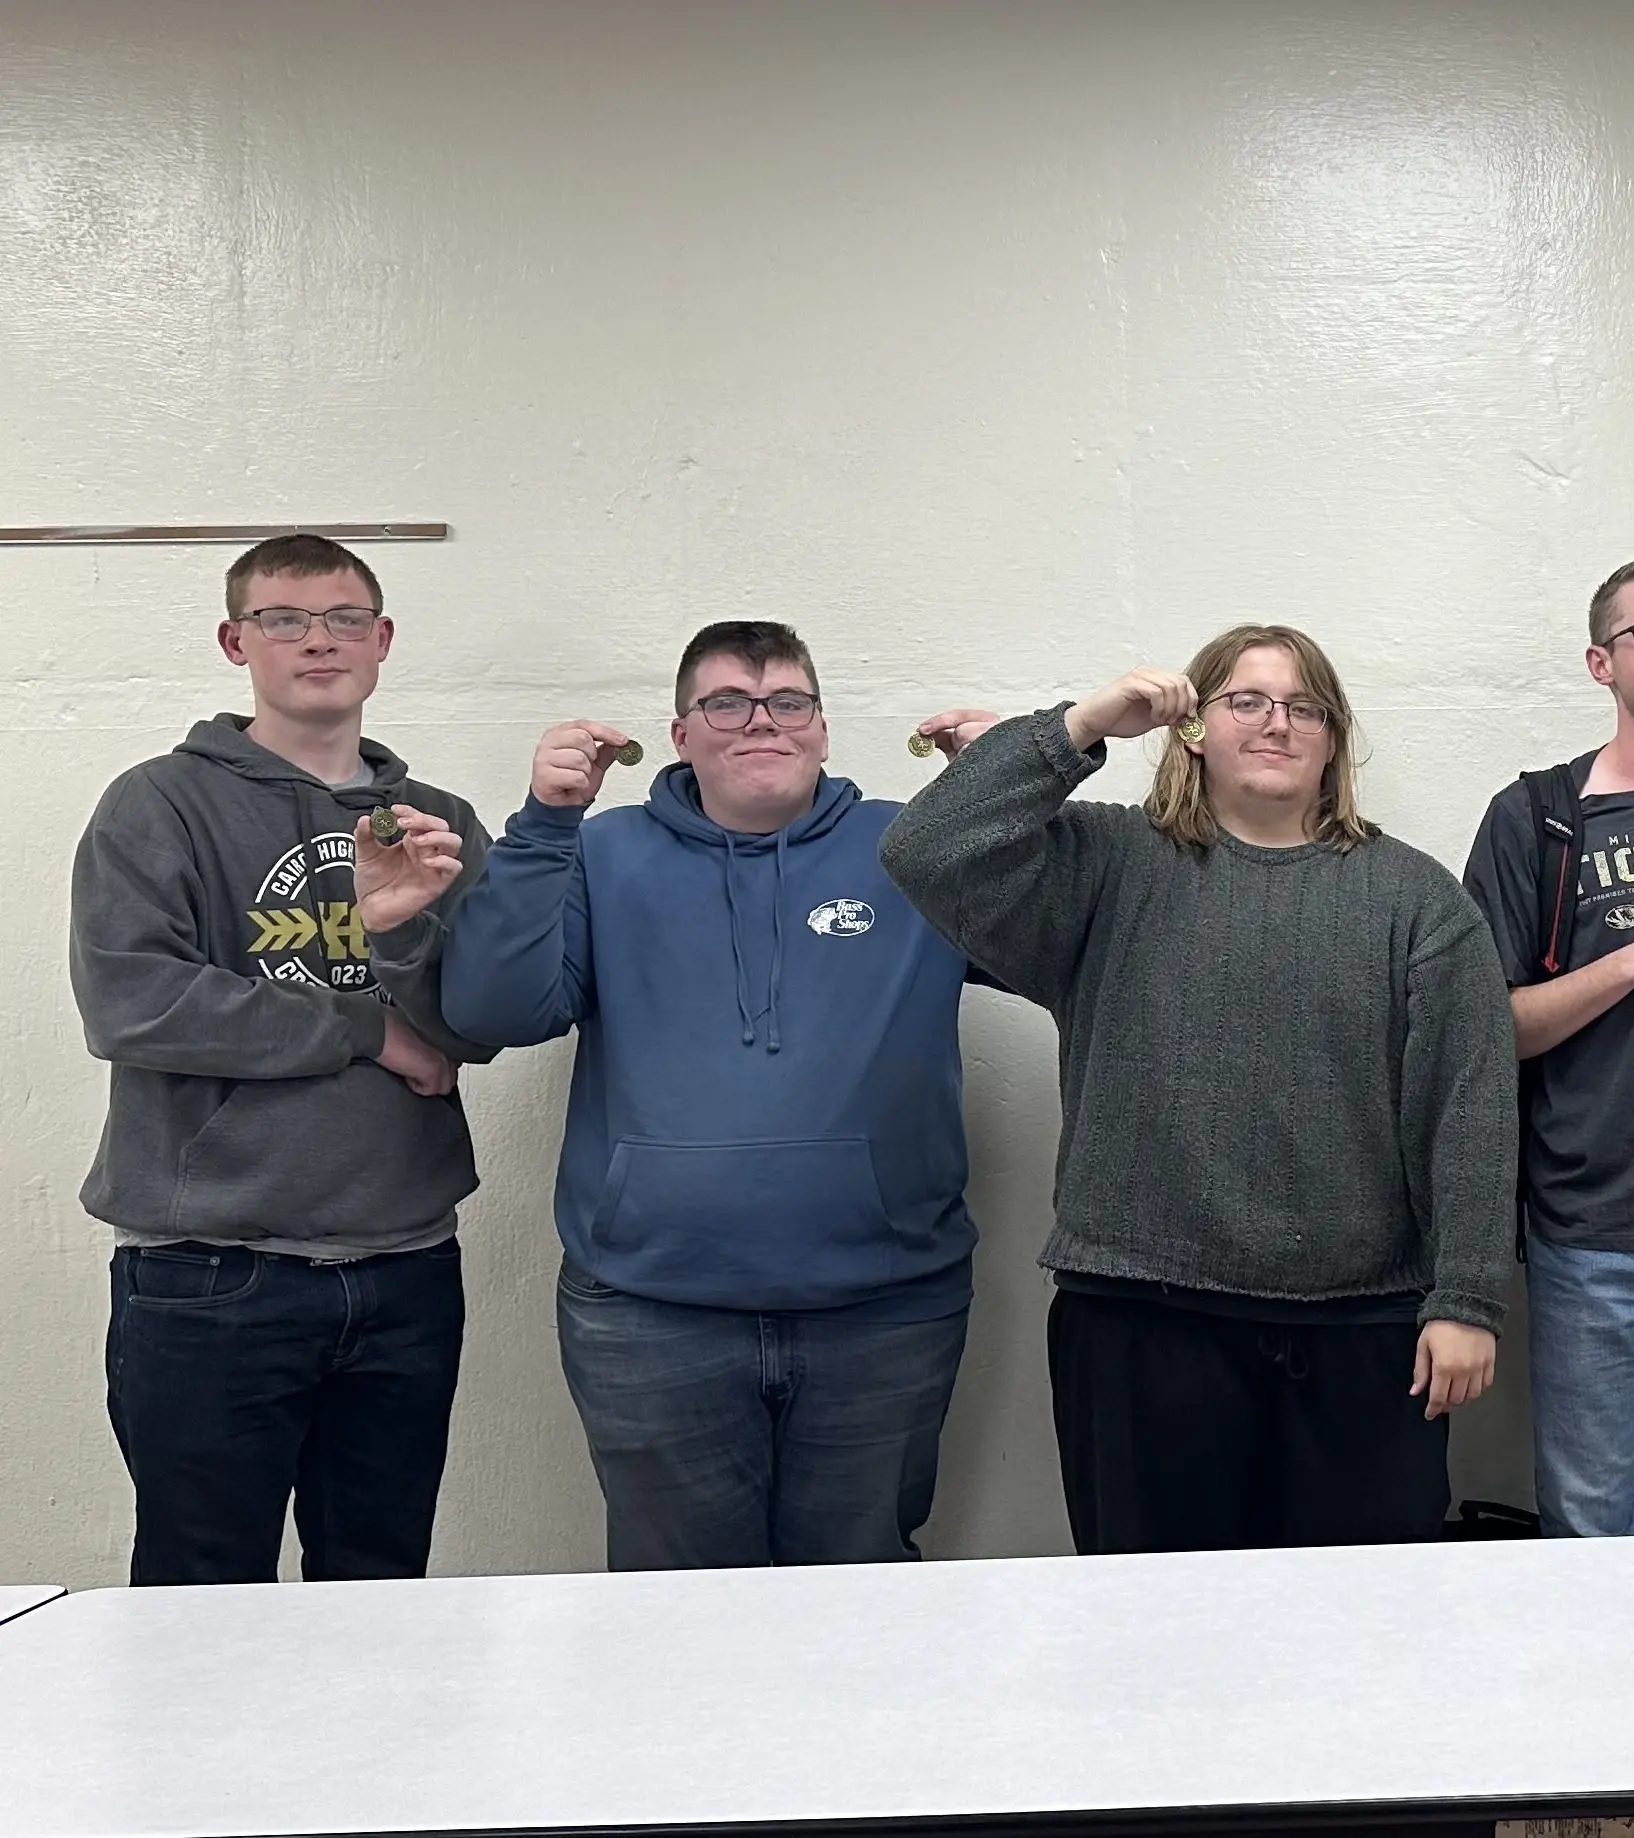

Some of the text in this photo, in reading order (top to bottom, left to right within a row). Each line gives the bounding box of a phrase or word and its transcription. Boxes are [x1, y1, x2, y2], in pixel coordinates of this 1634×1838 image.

[317, 840, 354, 861] HIGH
[836, 901, 863, 912] Bass
[837, 911, 857, 920] Pro
[836, 919, 870, 931] Shops
[331, 964, 367, 985] 023
